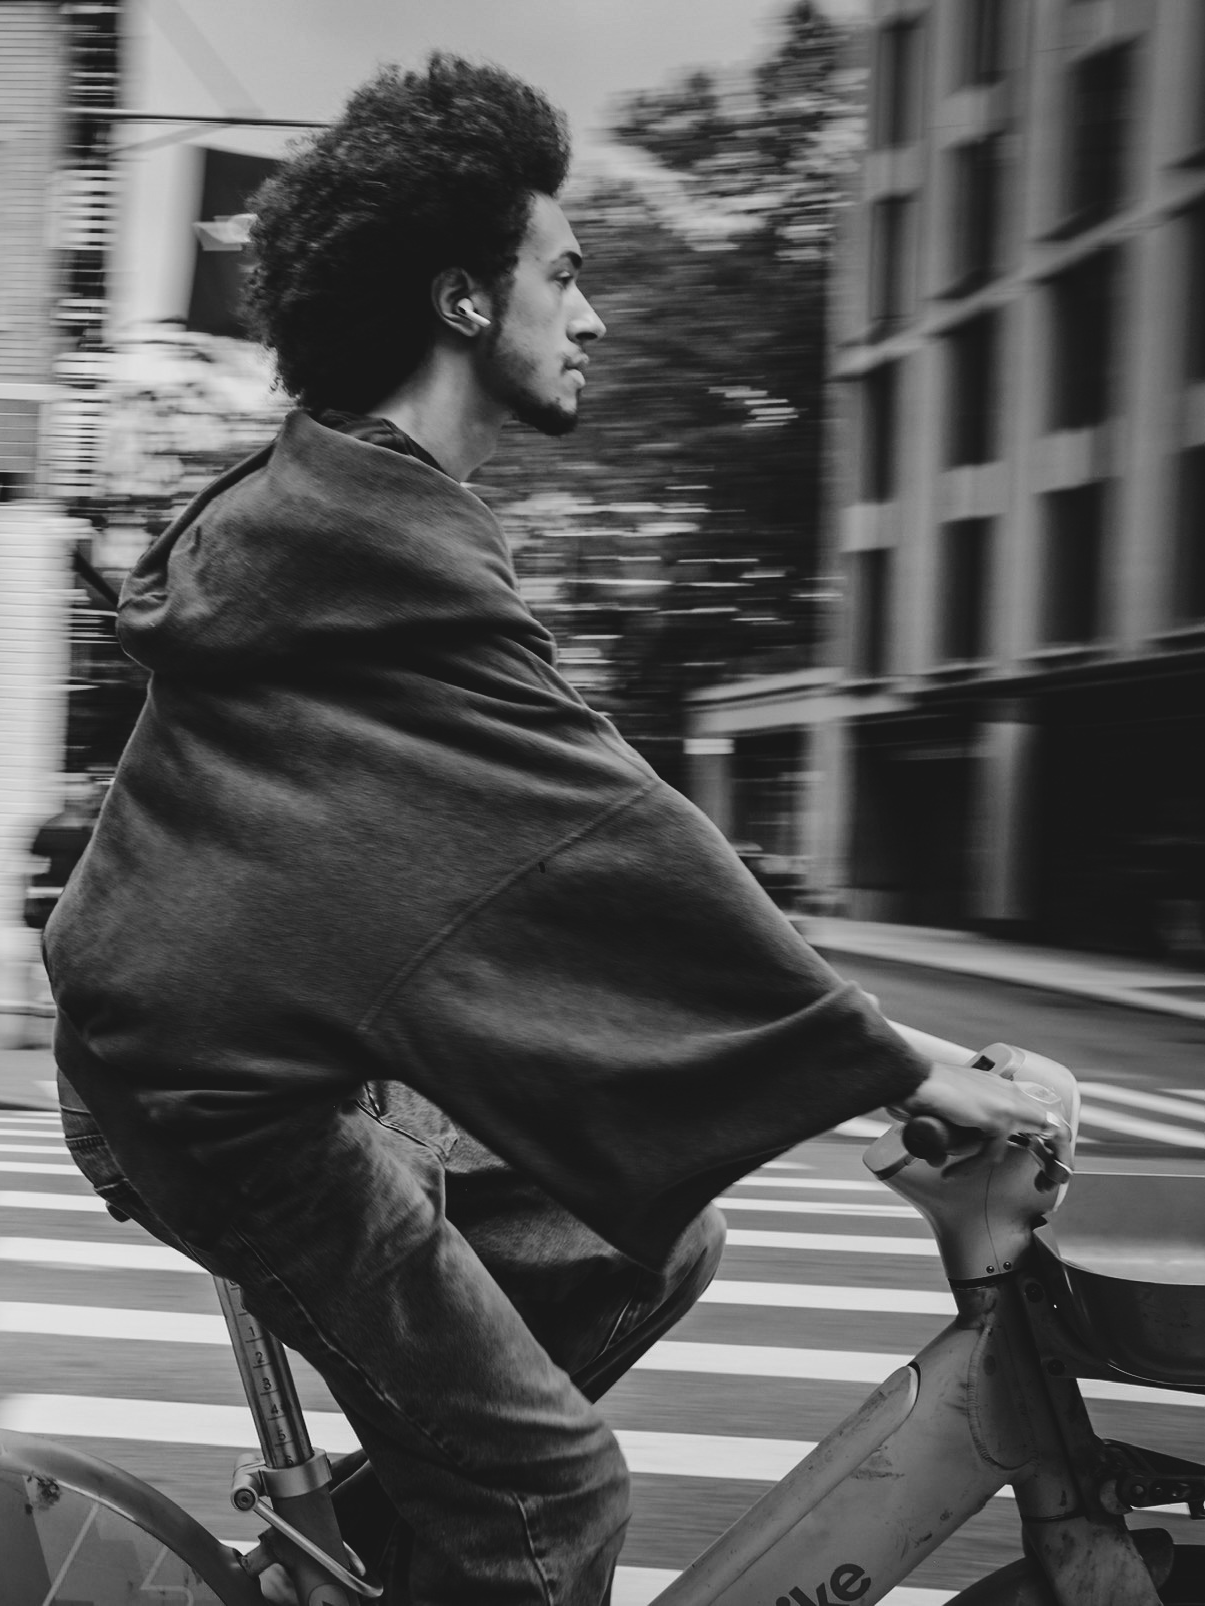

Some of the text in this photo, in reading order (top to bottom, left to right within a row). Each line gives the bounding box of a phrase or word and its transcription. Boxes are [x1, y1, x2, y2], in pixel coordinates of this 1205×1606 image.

[254, 1351, 265, 1364] 2
[262, 1378, 272, 1391] 3
[270, 1404, 280, 1416] 4
[277, 1428, 287, 1441] 5
